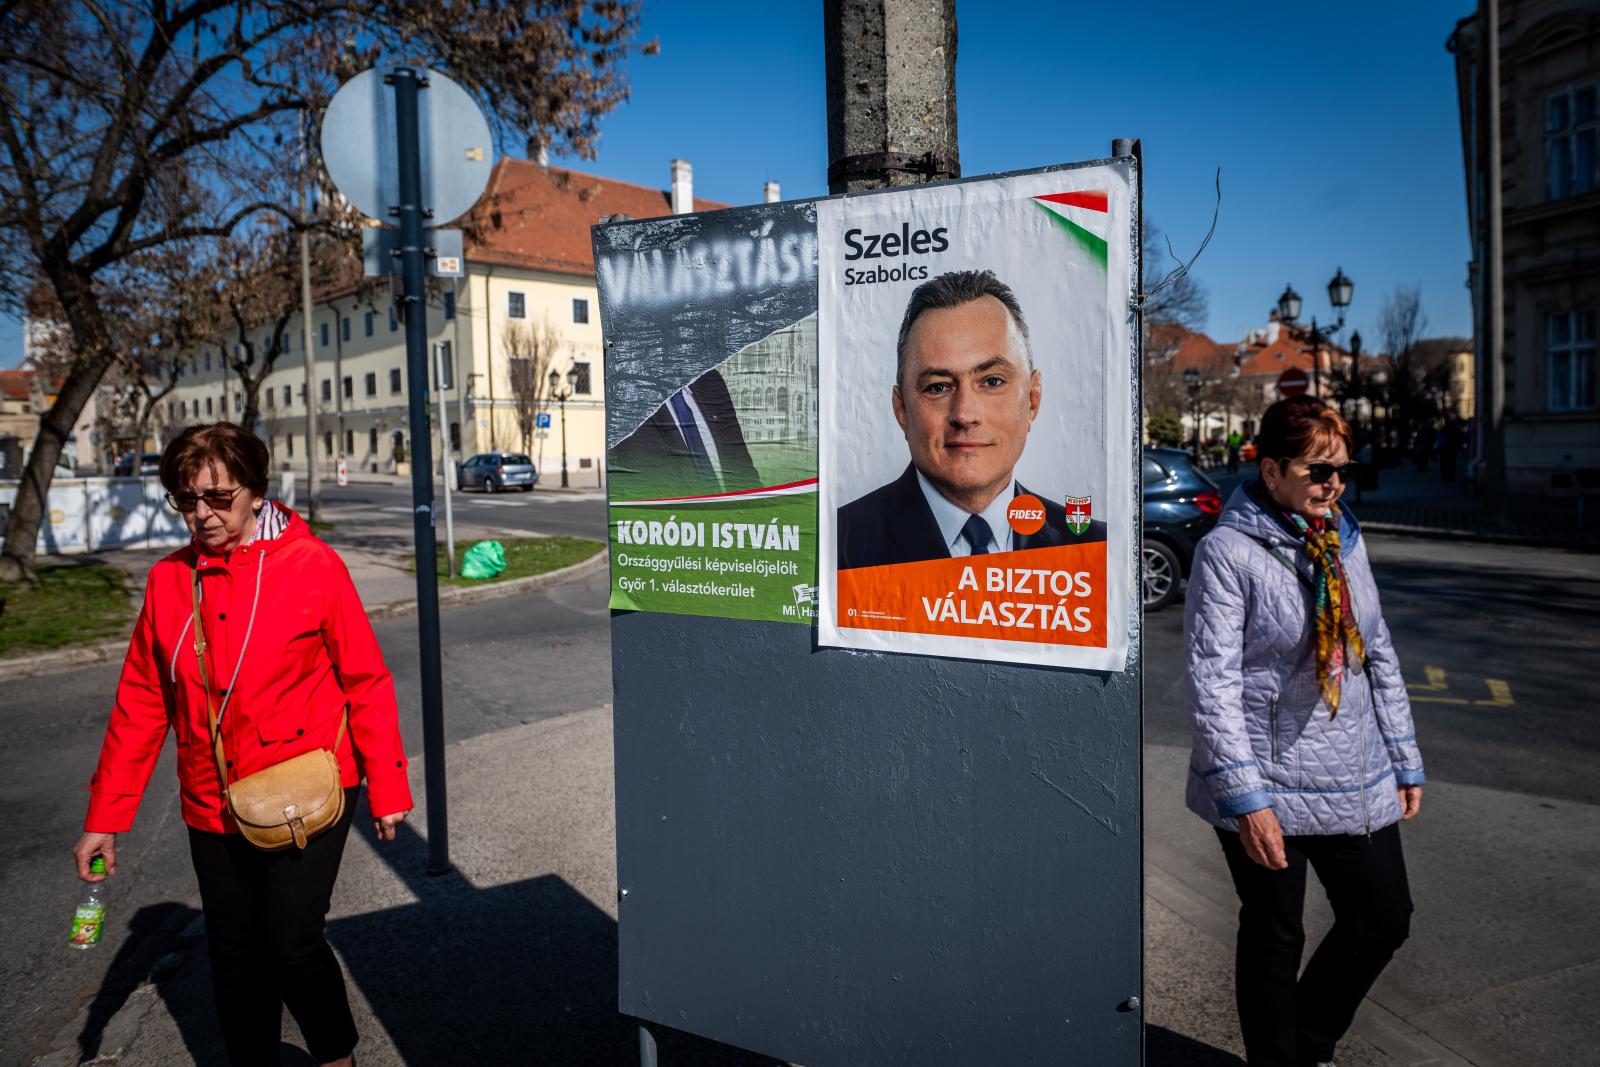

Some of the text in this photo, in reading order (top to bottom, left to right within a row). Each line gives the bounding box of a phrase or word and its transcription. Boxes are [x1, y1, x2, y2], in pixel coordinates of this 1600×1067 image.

[844, 223, 949, 261] Szeles
[844, 263, 928, 286] Szabolcs
[1009, 509, 1044, 520] FIDESZ
[617, 515, 800, 551] KORÓDI ISTVÁN
[618, 553, 798, 578] Országgyűlési képviselőjelölt
[619, 577, 755, 598] Győr 1. választókerület
[958, 566, 1092, 597] A BIZTOS
[782, 604, 796, 616] Mi
[847, 608, 860, 617] 01.
[922, 591, 1092, 633] VÁLASZTÁS
